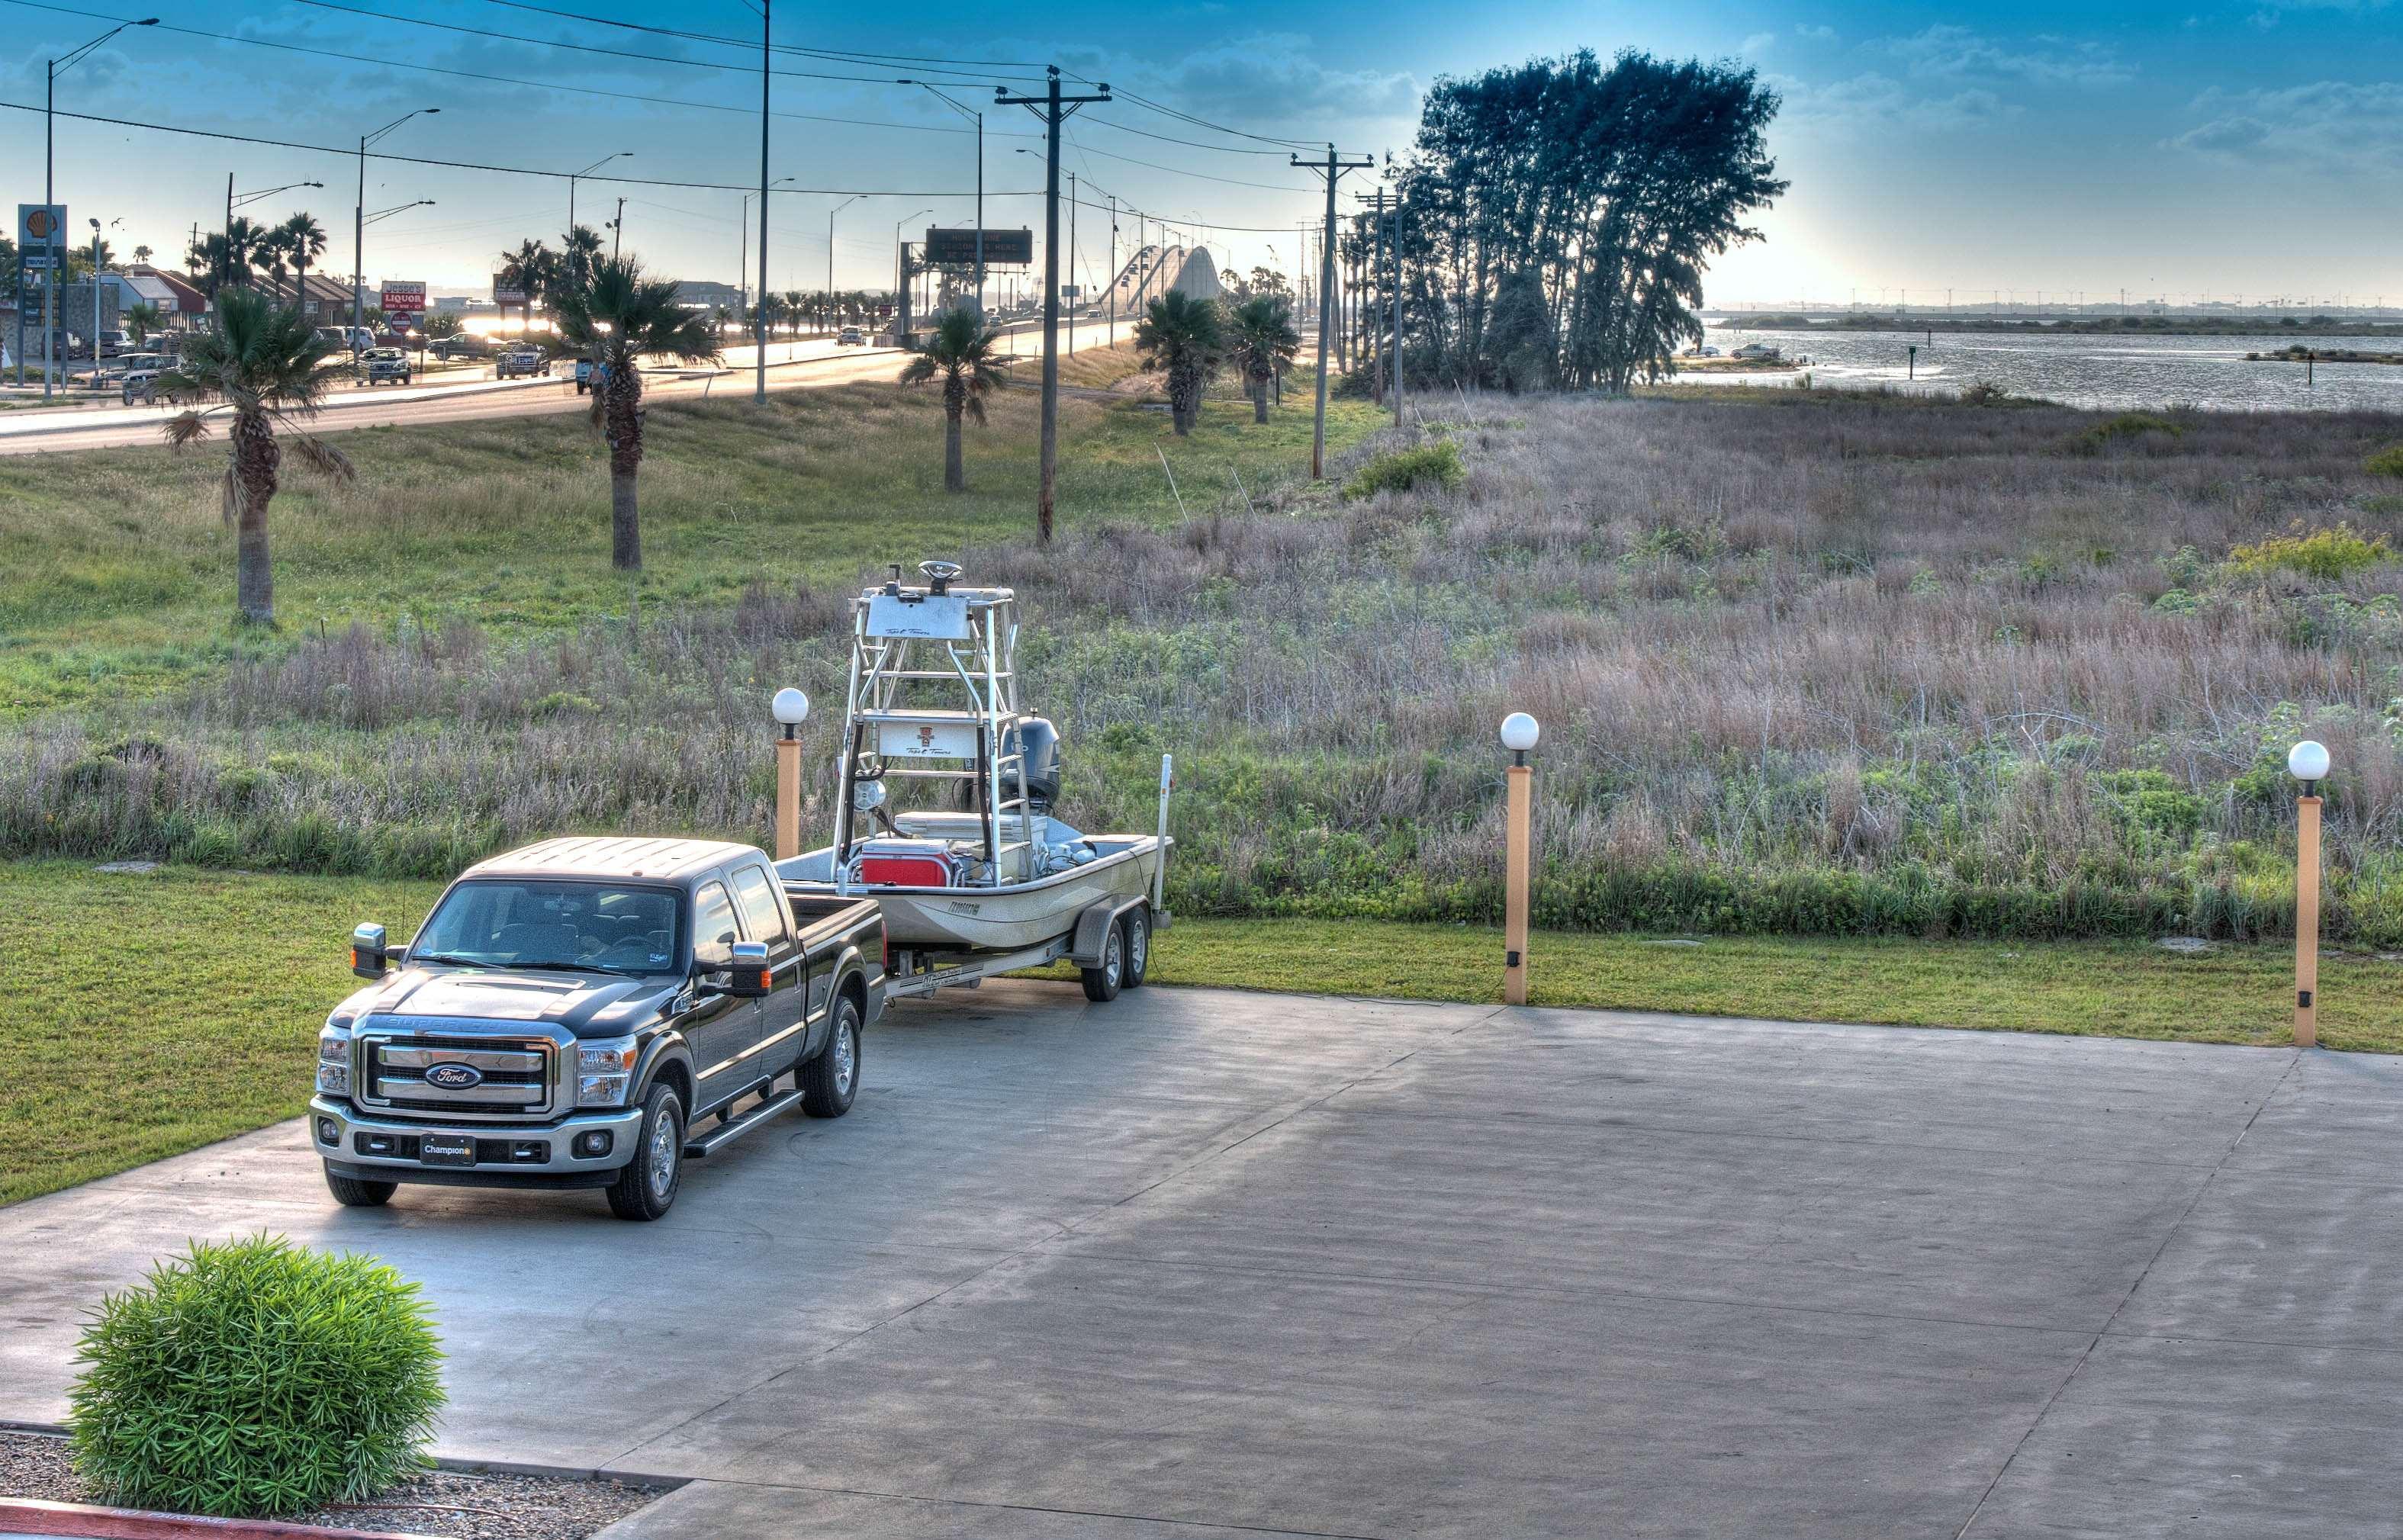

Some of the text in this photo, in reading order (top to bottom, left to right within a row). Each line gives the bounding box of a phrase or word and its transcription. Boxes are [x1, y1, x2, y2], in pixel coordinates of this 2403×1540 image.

[387, 284, 421, 293] Jesse's
[385, 1018, 540, 1030] SUPER DUTY
[437, 1069, 467, 1082] Ford
[424, 1145, 465, 1155] Champion
[147, 1512, 230, 1524] PARKING
